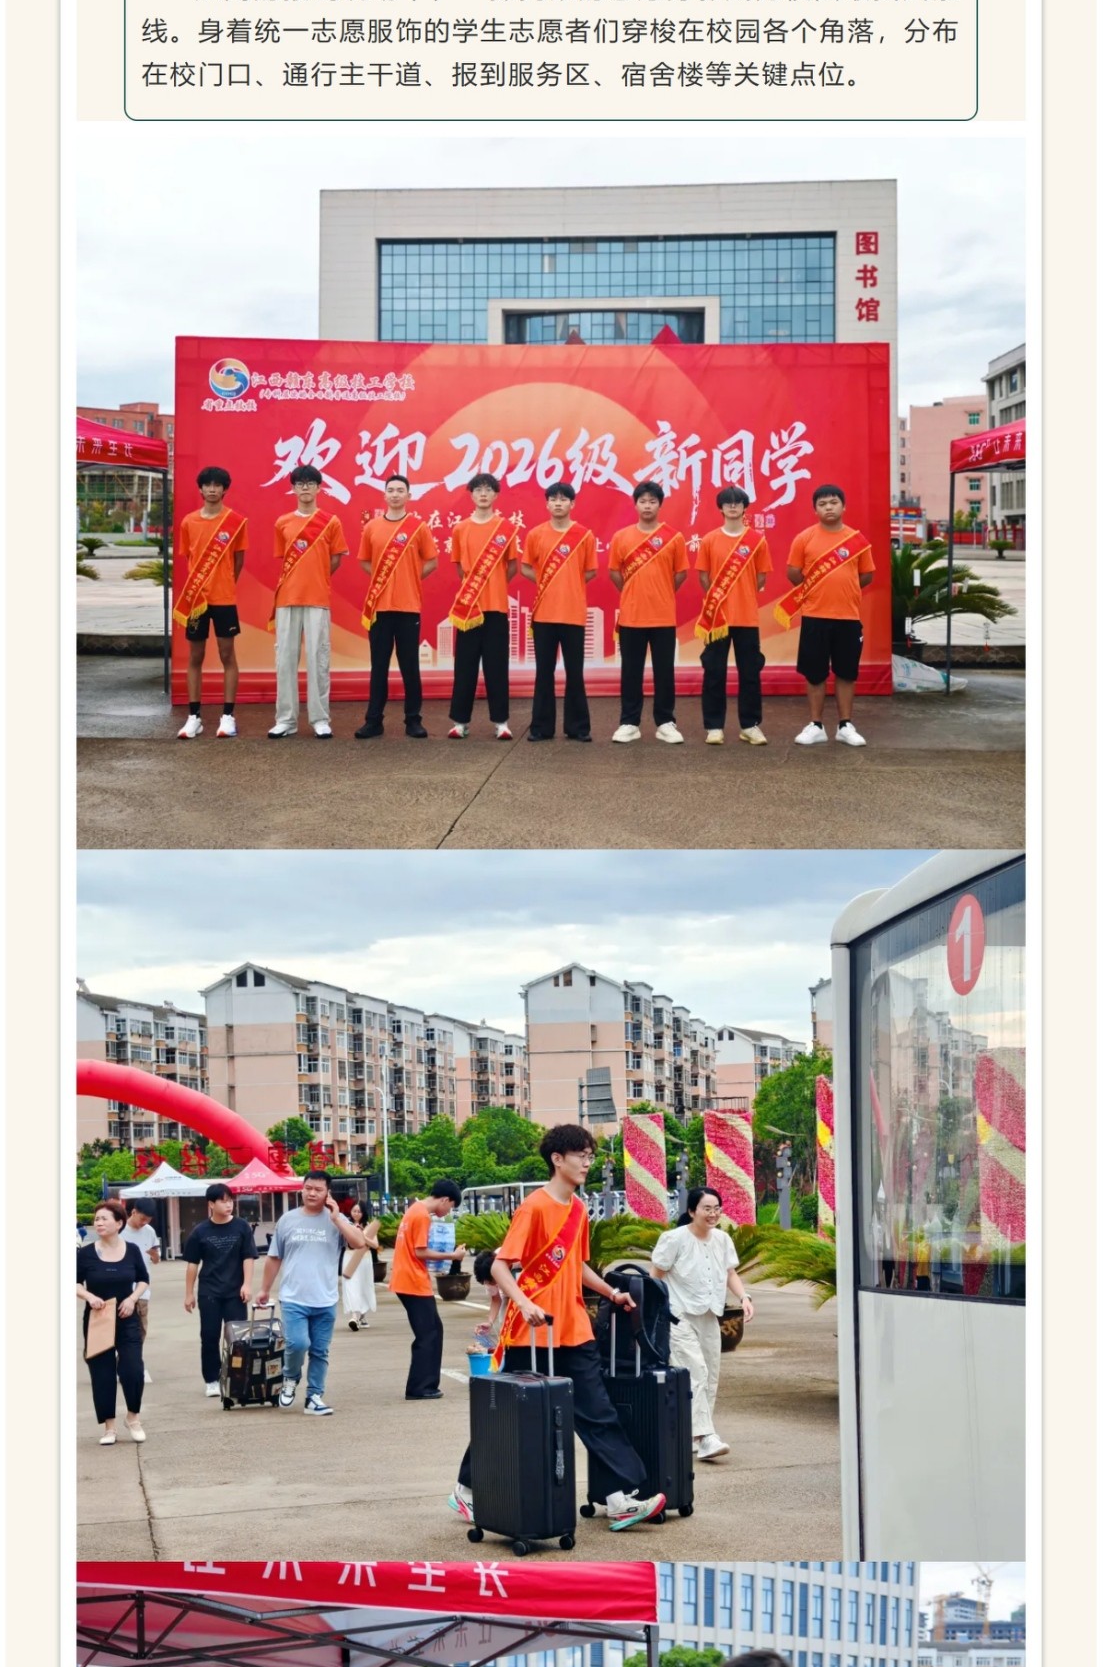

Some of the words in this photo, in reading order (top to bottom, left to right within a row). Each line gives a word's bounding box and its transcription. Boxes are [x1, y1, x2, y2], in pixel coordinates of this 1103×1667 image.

[855, 231, 881, 322] 图书馆
[251, 371, 415, 391] 江西赣东高级技工学校
[953, 903, 975, 983] 1
